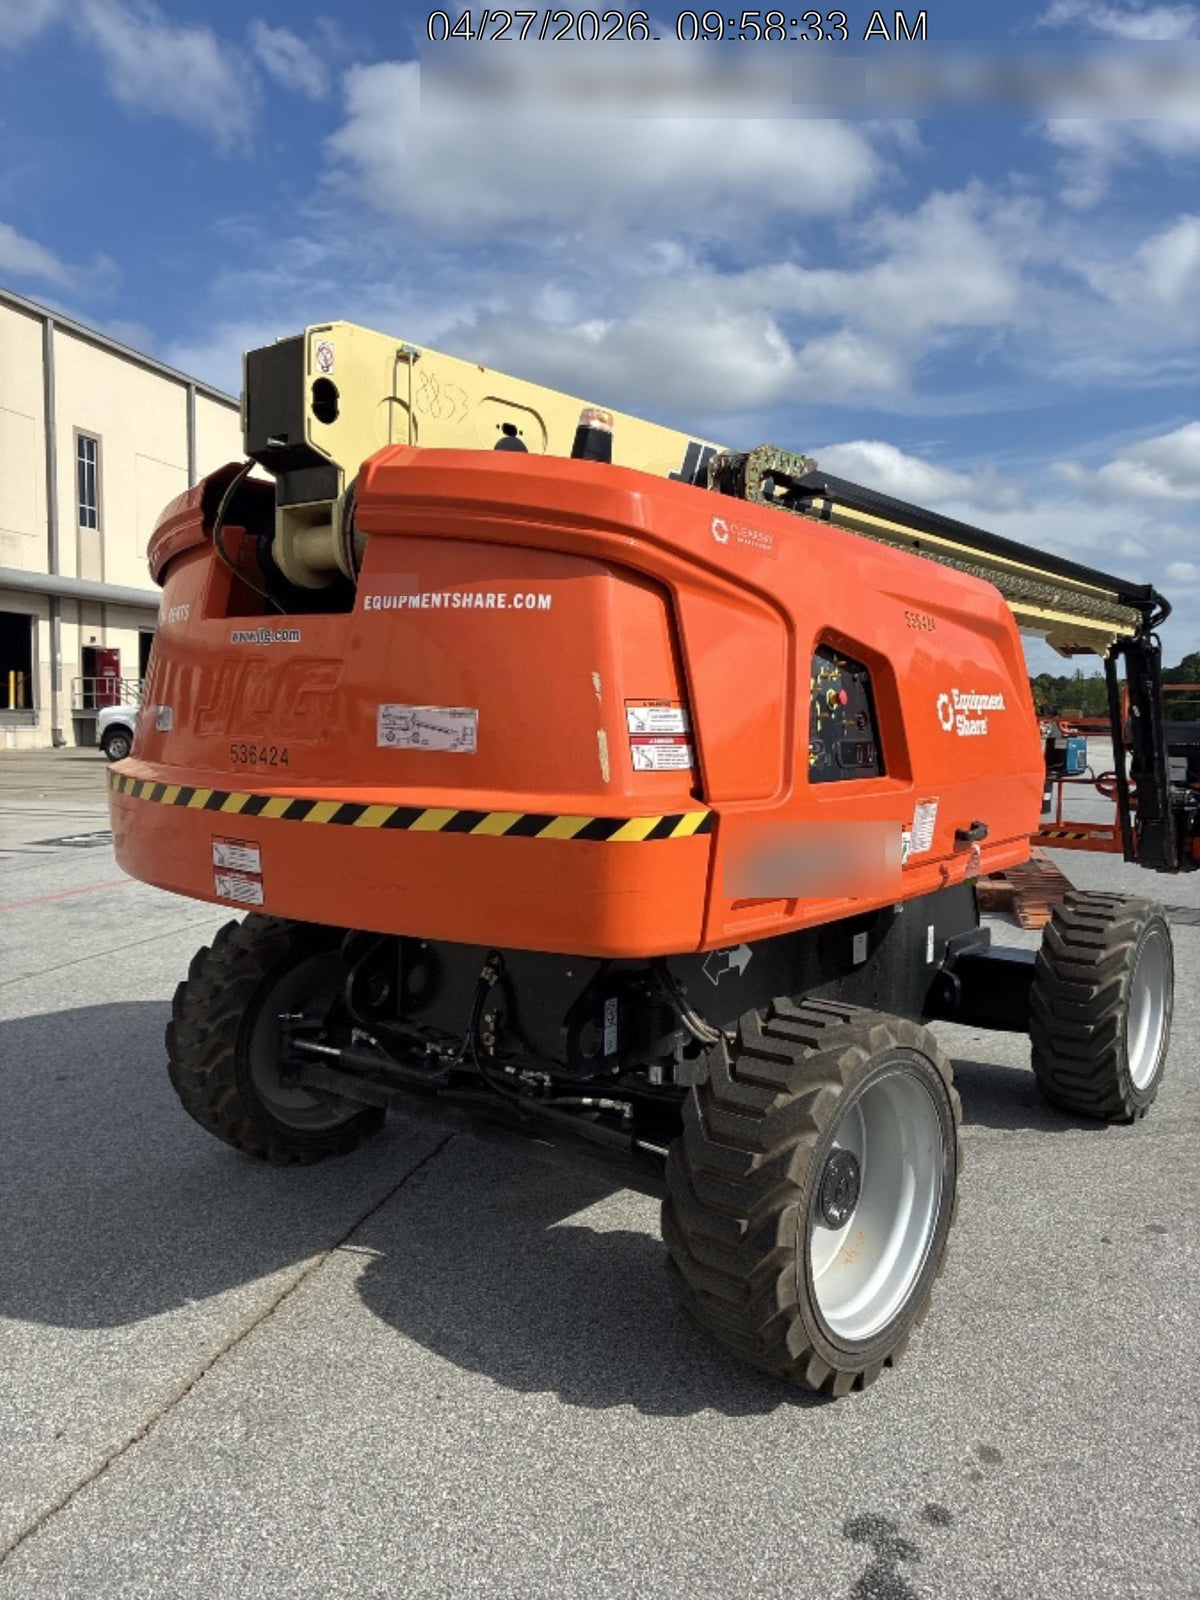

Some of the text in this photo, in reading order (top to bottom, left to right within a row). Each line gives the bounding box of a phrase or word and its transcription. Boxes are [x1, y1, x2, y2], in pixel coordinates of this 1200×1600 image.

[363, 592, 552, 610] EQUIPMENTSHARE.COM
[231, 627, 300, 645] www.jlg.com
[951, 688, 1006, 715] Equipment
[956, 714, 988, 737] Share
[230, 744, 290, 767] 536424
